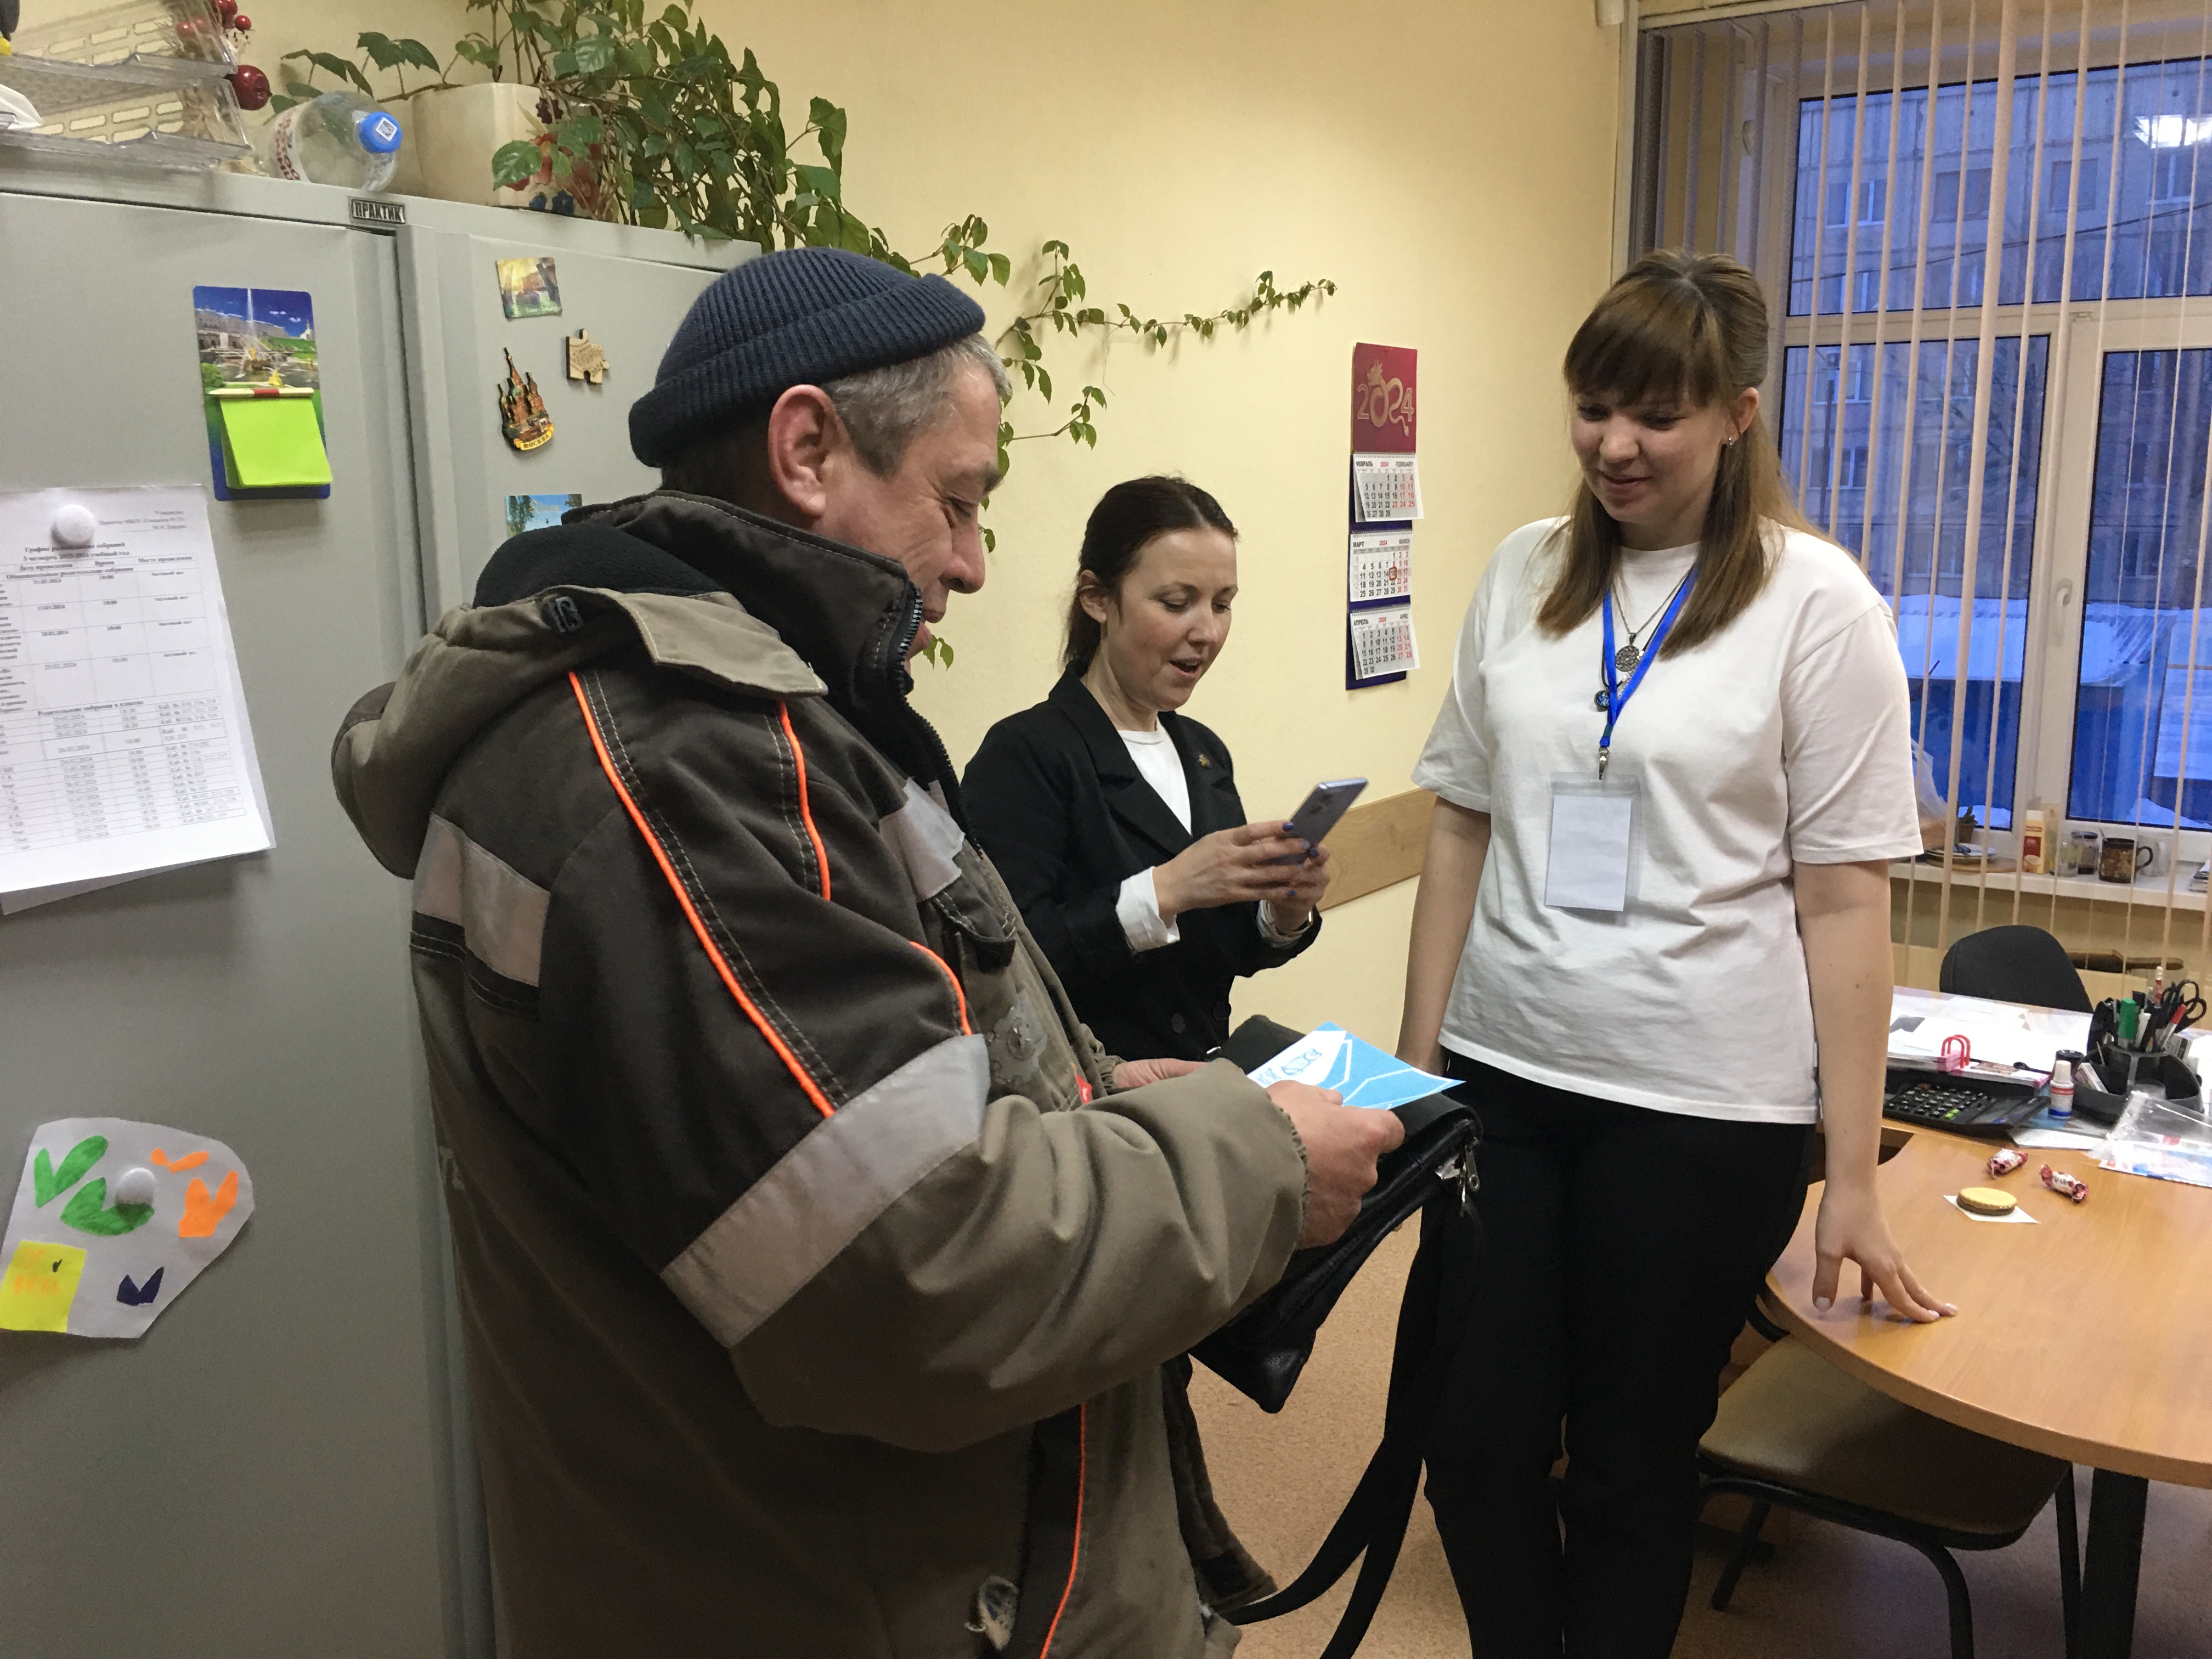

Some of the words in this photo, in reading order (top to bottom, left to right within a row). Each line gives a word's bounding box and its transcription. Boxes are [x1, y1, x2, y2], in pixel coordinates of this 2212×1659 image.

[354, 201, 405, 222] ПРАКТИК
[1357, 377, 1414, 429] 2024
[523, 434, 549, 448] МОСКВА
